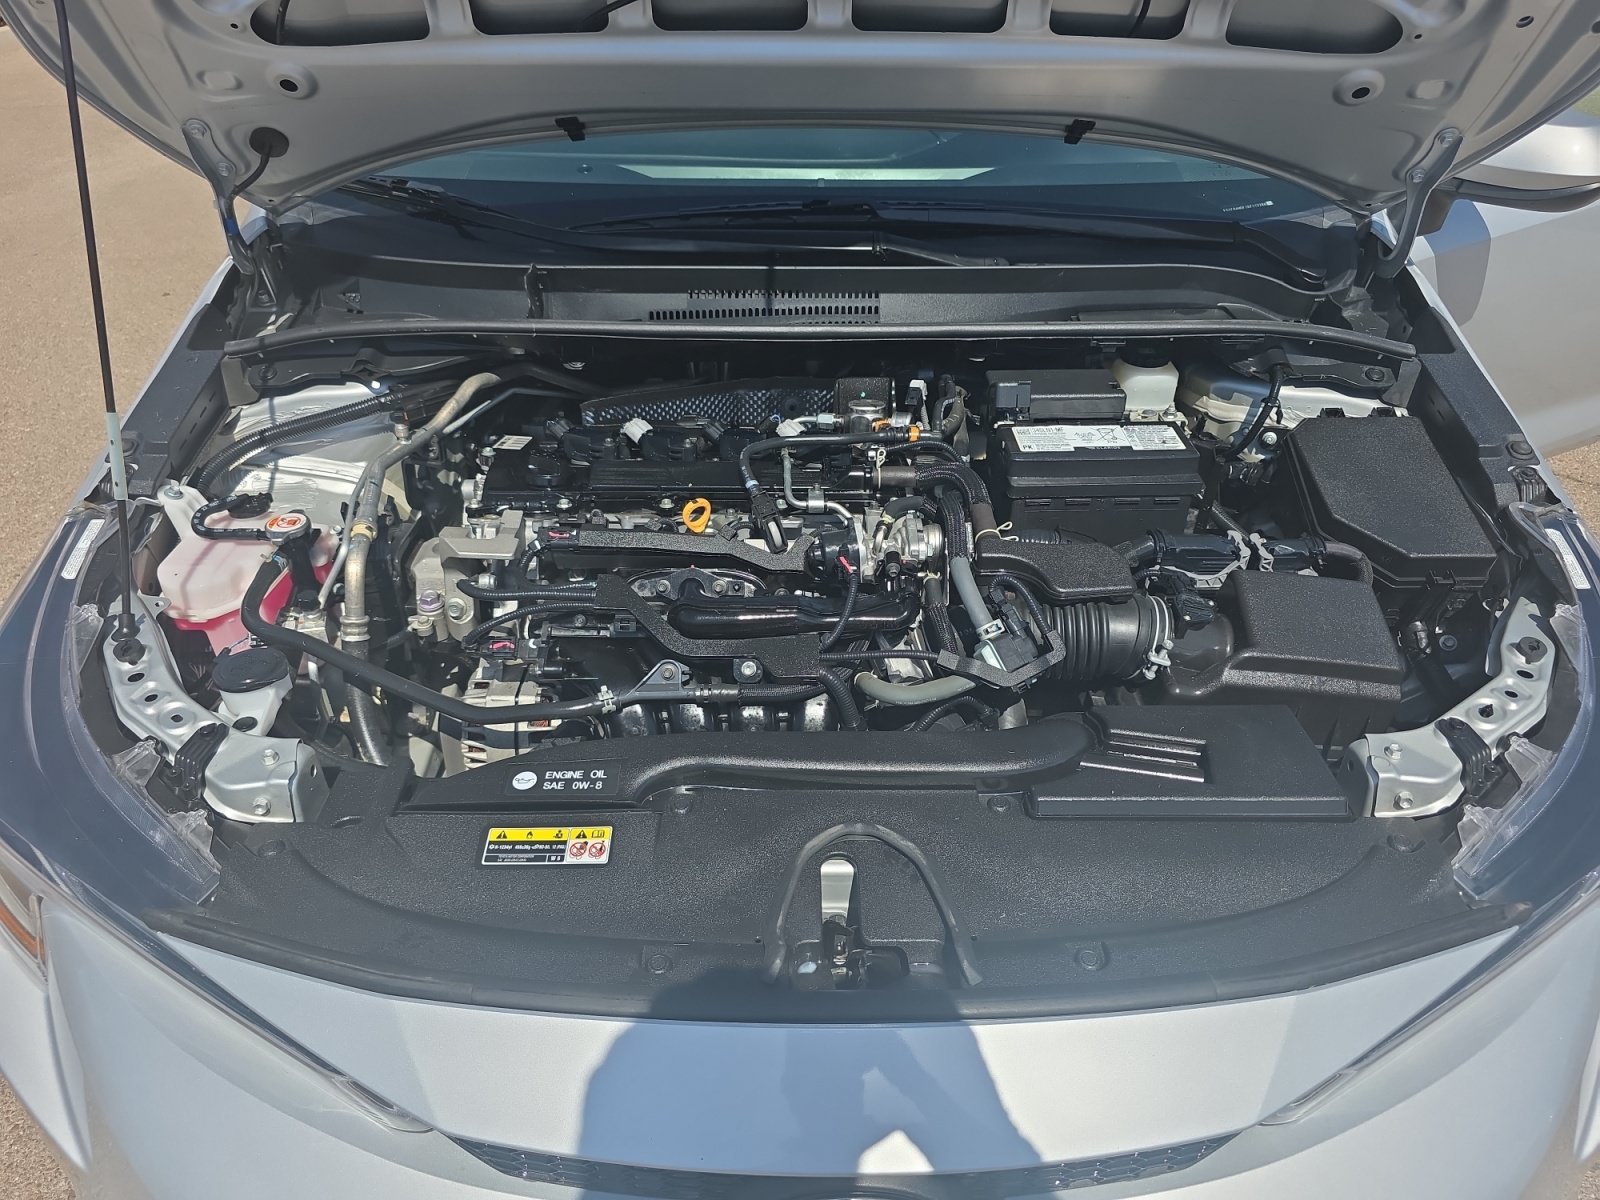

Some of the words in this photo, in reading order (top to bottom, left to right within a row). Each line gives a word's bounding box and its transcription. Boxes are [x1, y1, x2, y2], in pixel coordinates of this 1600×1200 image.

[545, 770, 584, 779] ENGINE
[590, 769, 607, 779] OIL
[542, 781, 565, 790] SAE
[572, 780, 602, 790] 0W-8
